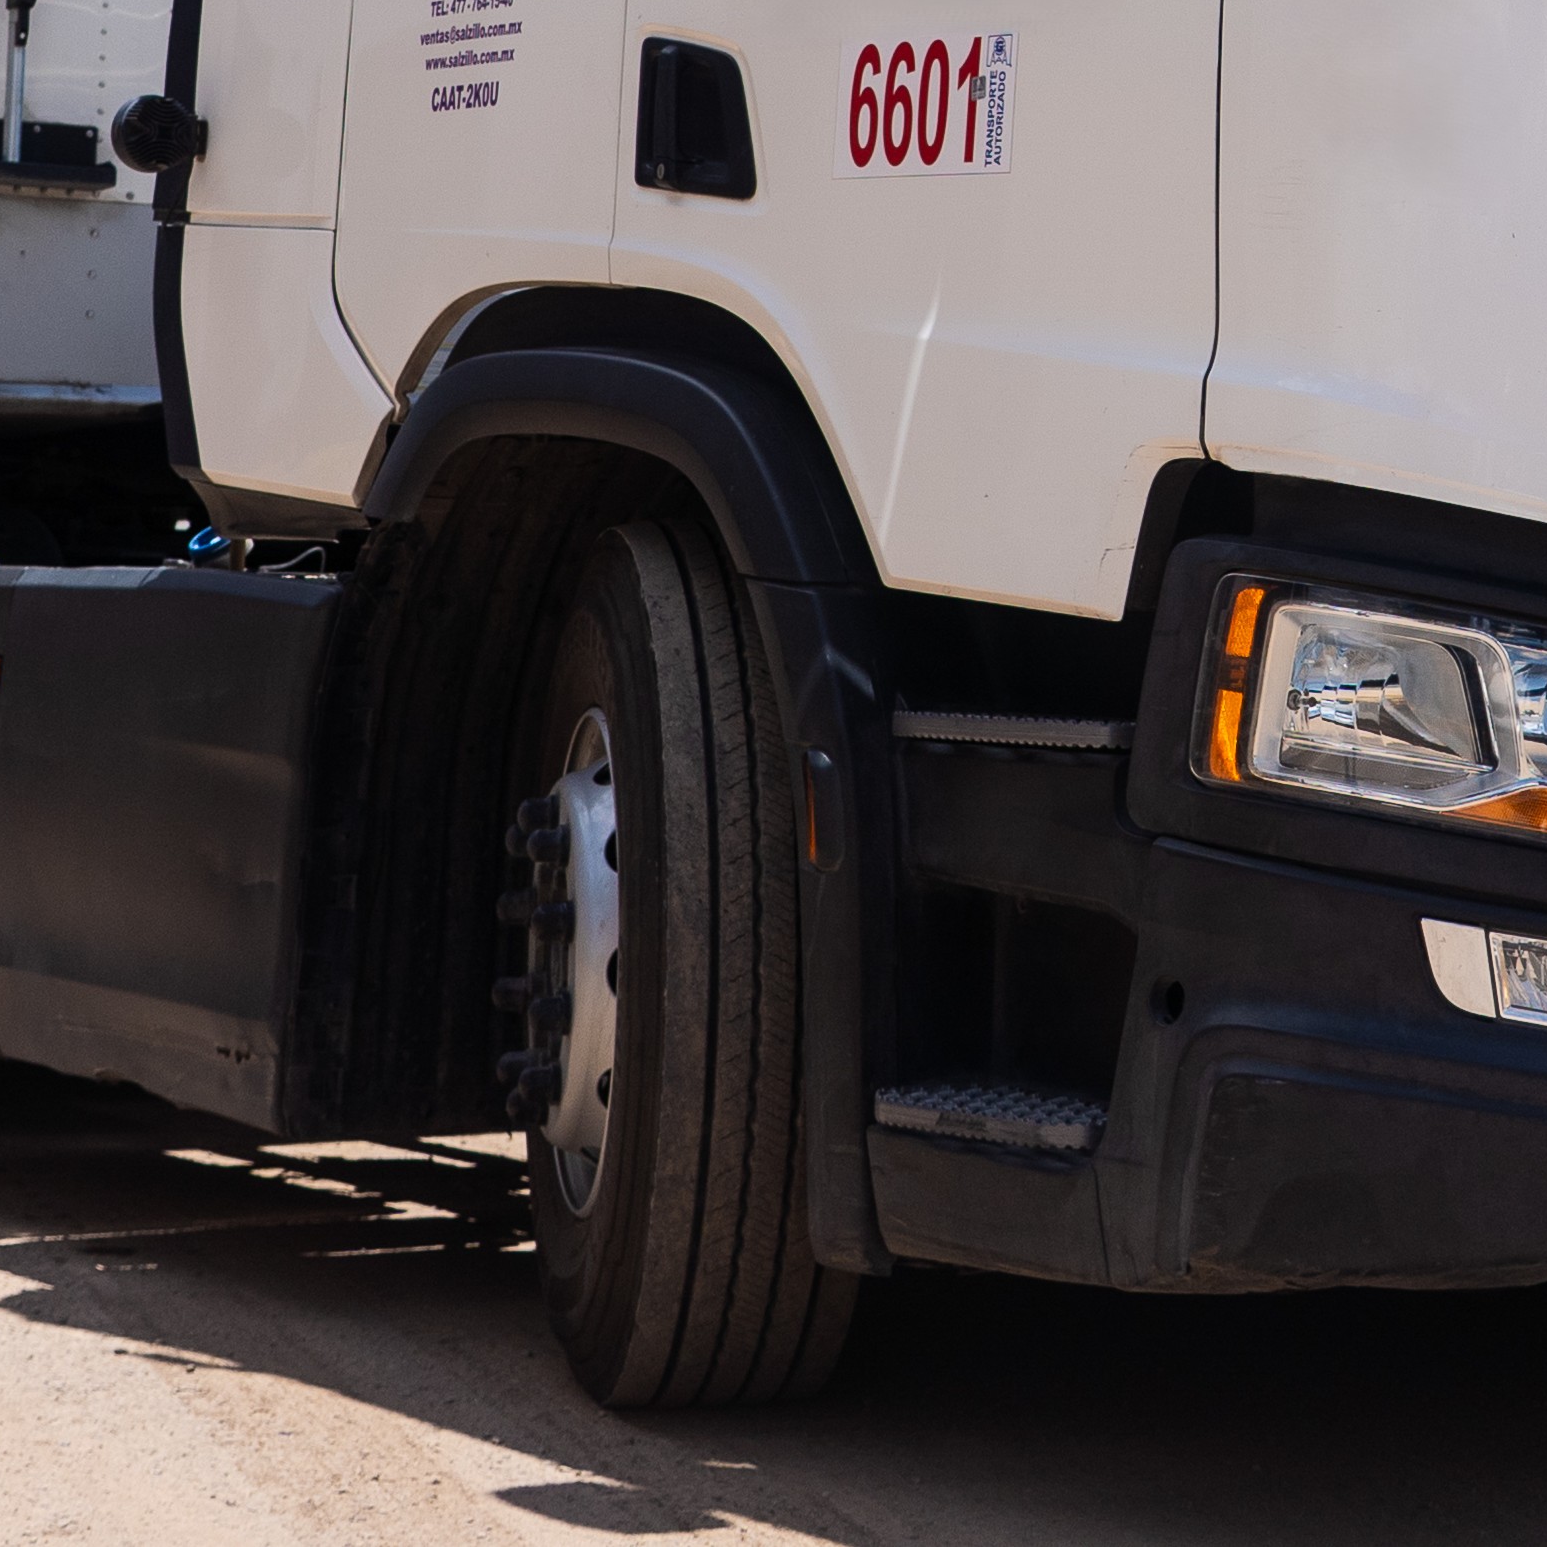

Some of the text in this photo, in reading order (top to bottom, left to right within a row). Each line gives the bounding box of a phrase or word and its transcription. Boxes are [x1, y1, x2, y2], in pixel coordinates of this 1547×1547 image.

[431, 1, 449, 17] TEL:
[849, 36, 982, 168] 6601
[984, 69, 998, 168] TRANSPORTE
[992, 70, 1007, 165] AUTORIZADO
